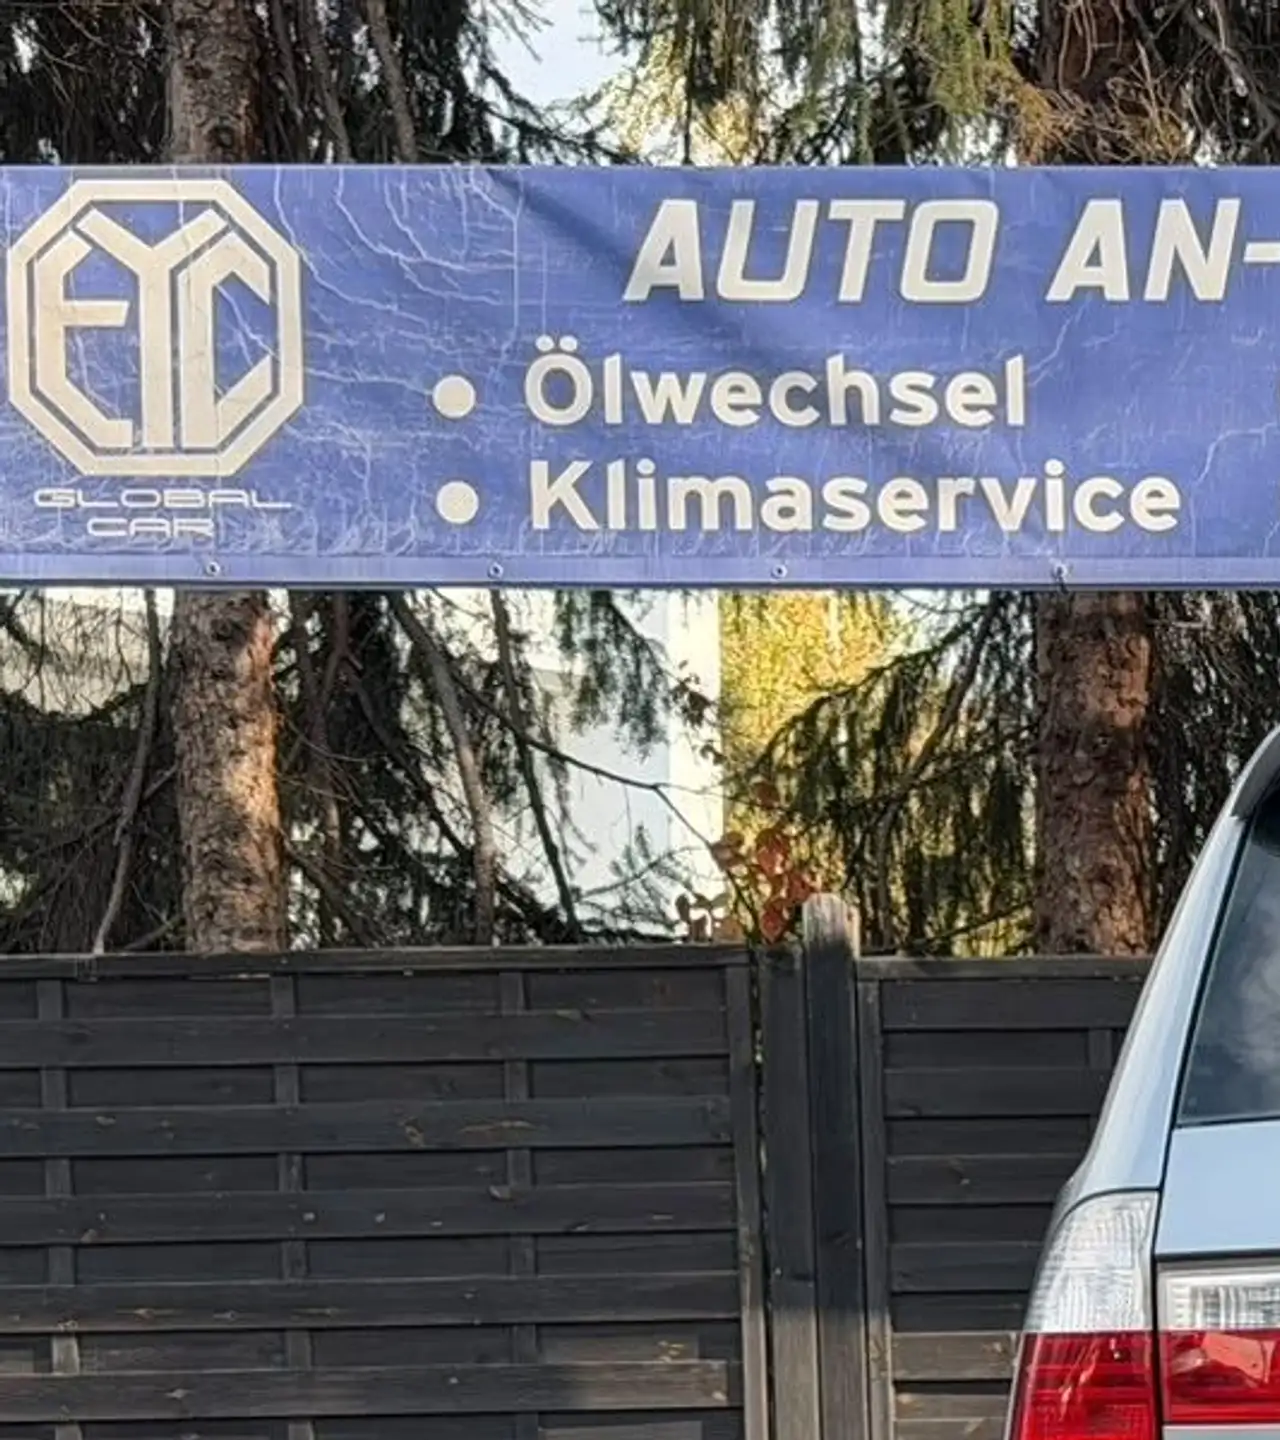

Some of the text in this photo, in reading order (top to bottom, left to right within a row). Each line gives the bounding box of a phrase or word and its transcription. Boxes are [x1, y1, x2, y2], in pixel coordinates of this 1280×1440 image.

[624, 199, 998, 302] AUTO
[525, 335, 1025, 427] Ölwechsel
[33, 487, 293, 509] GLOBAL
[86, 516, 215, 538] CAR
[530, 458, 1181, 541] Klimaservice
